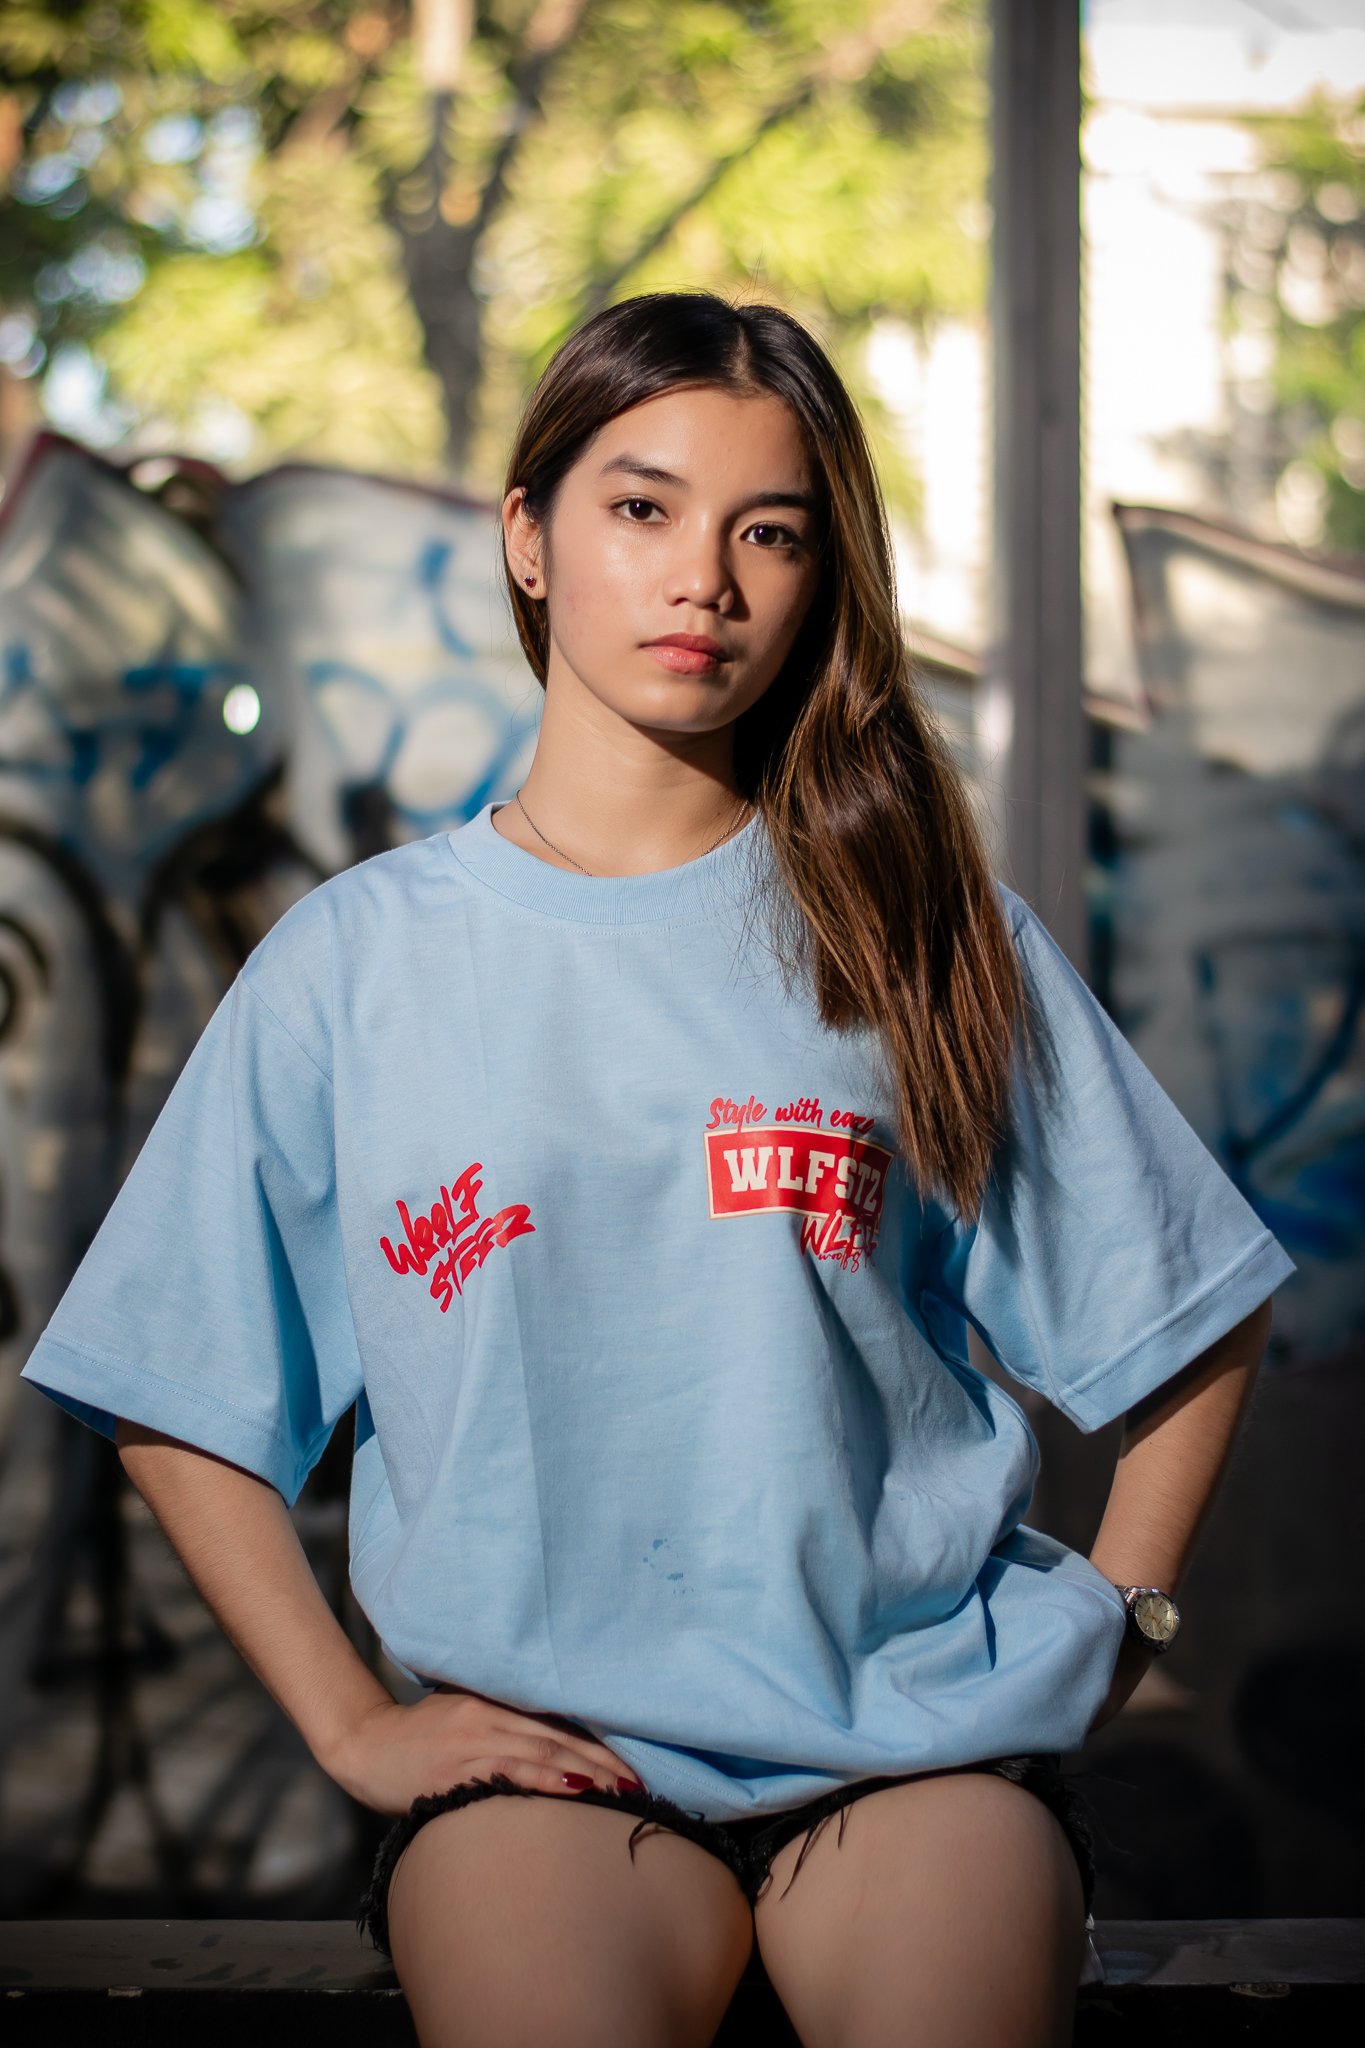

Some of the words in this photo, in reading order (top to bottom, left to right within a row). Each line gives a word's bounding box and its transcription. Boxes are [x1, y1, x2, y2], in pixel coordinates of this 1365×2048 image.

[706, 1095, 767, 1133] Style
[775, 1097, 823, 1128] with
[723, 1146, 881, 1212] WLFSTZ
